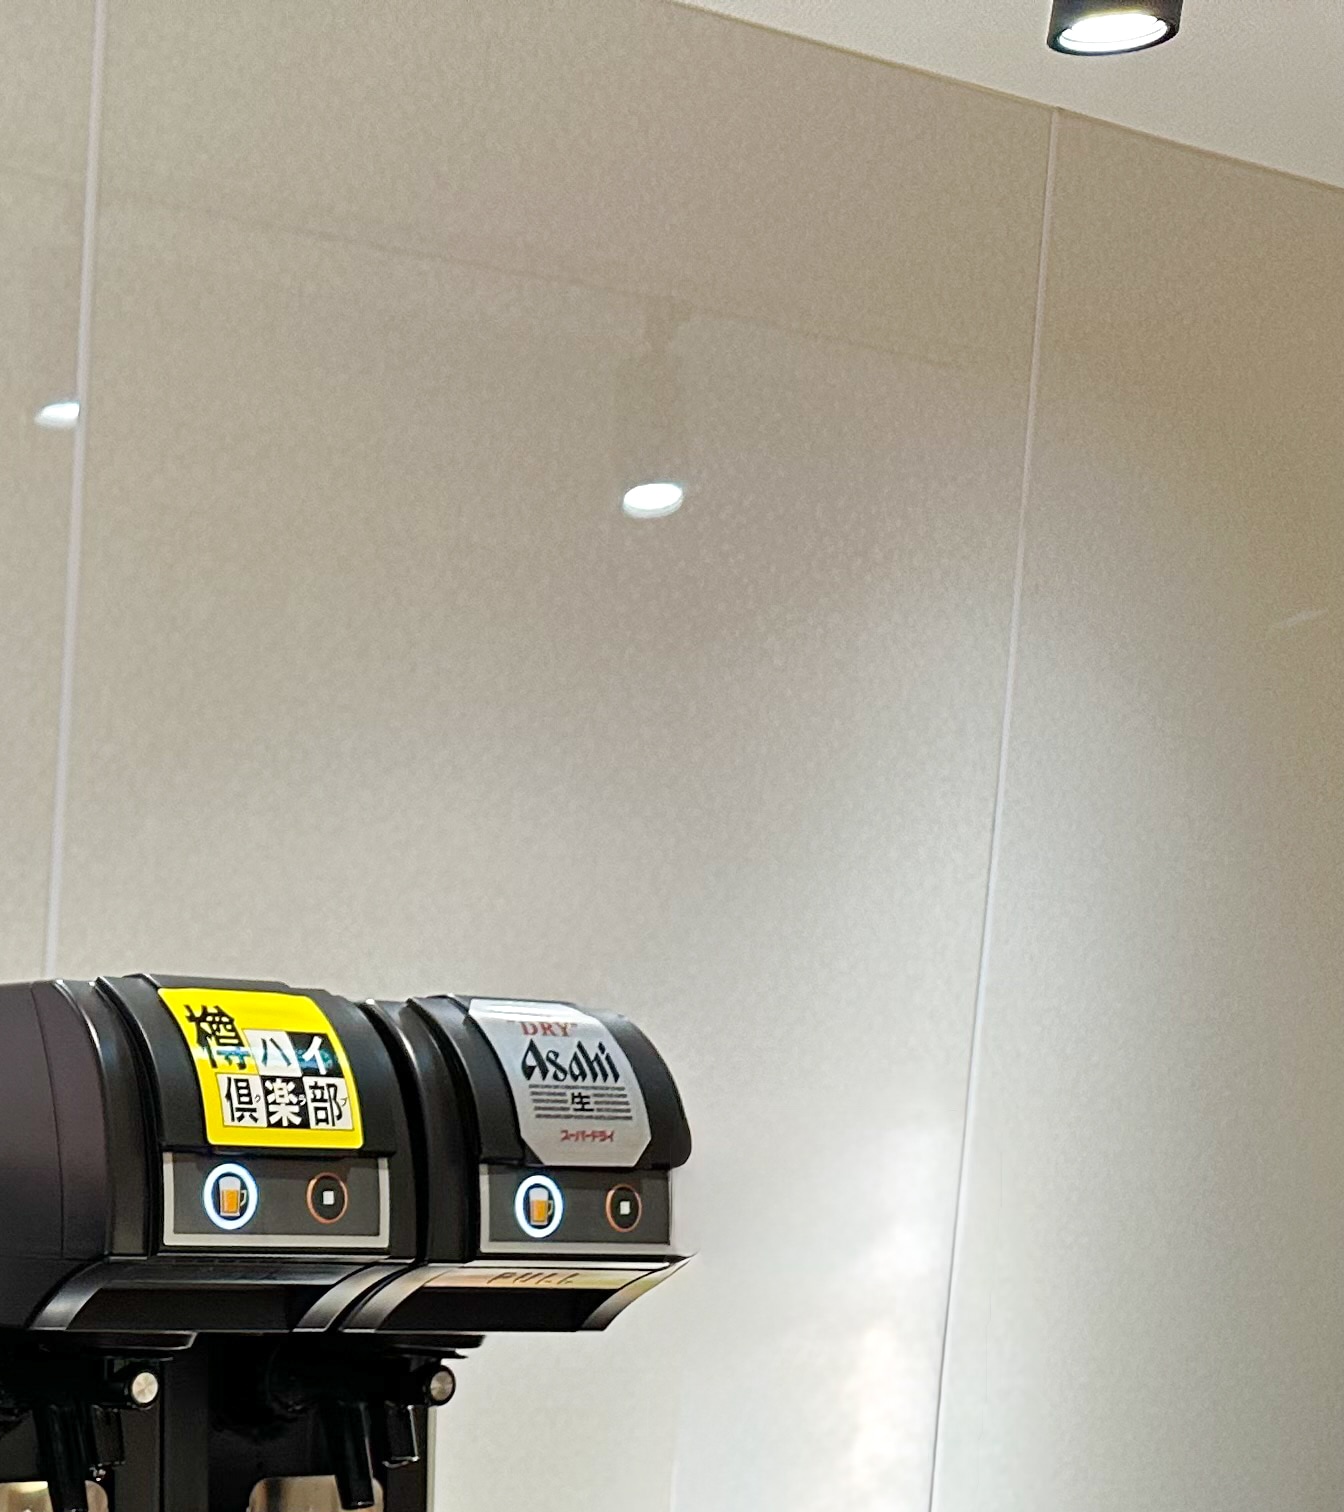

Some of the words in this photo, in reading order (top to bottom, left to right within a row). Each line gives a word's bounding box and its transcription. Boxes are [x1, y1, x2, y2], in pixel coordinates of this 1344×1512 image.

[521, 1038, 621, 1084] Asahi
[223, 1075, 343, 1127] 倶楽部
[570, 1091, 596, 1112] 生
[560, 1129, 615, 1143] スーパードライ
